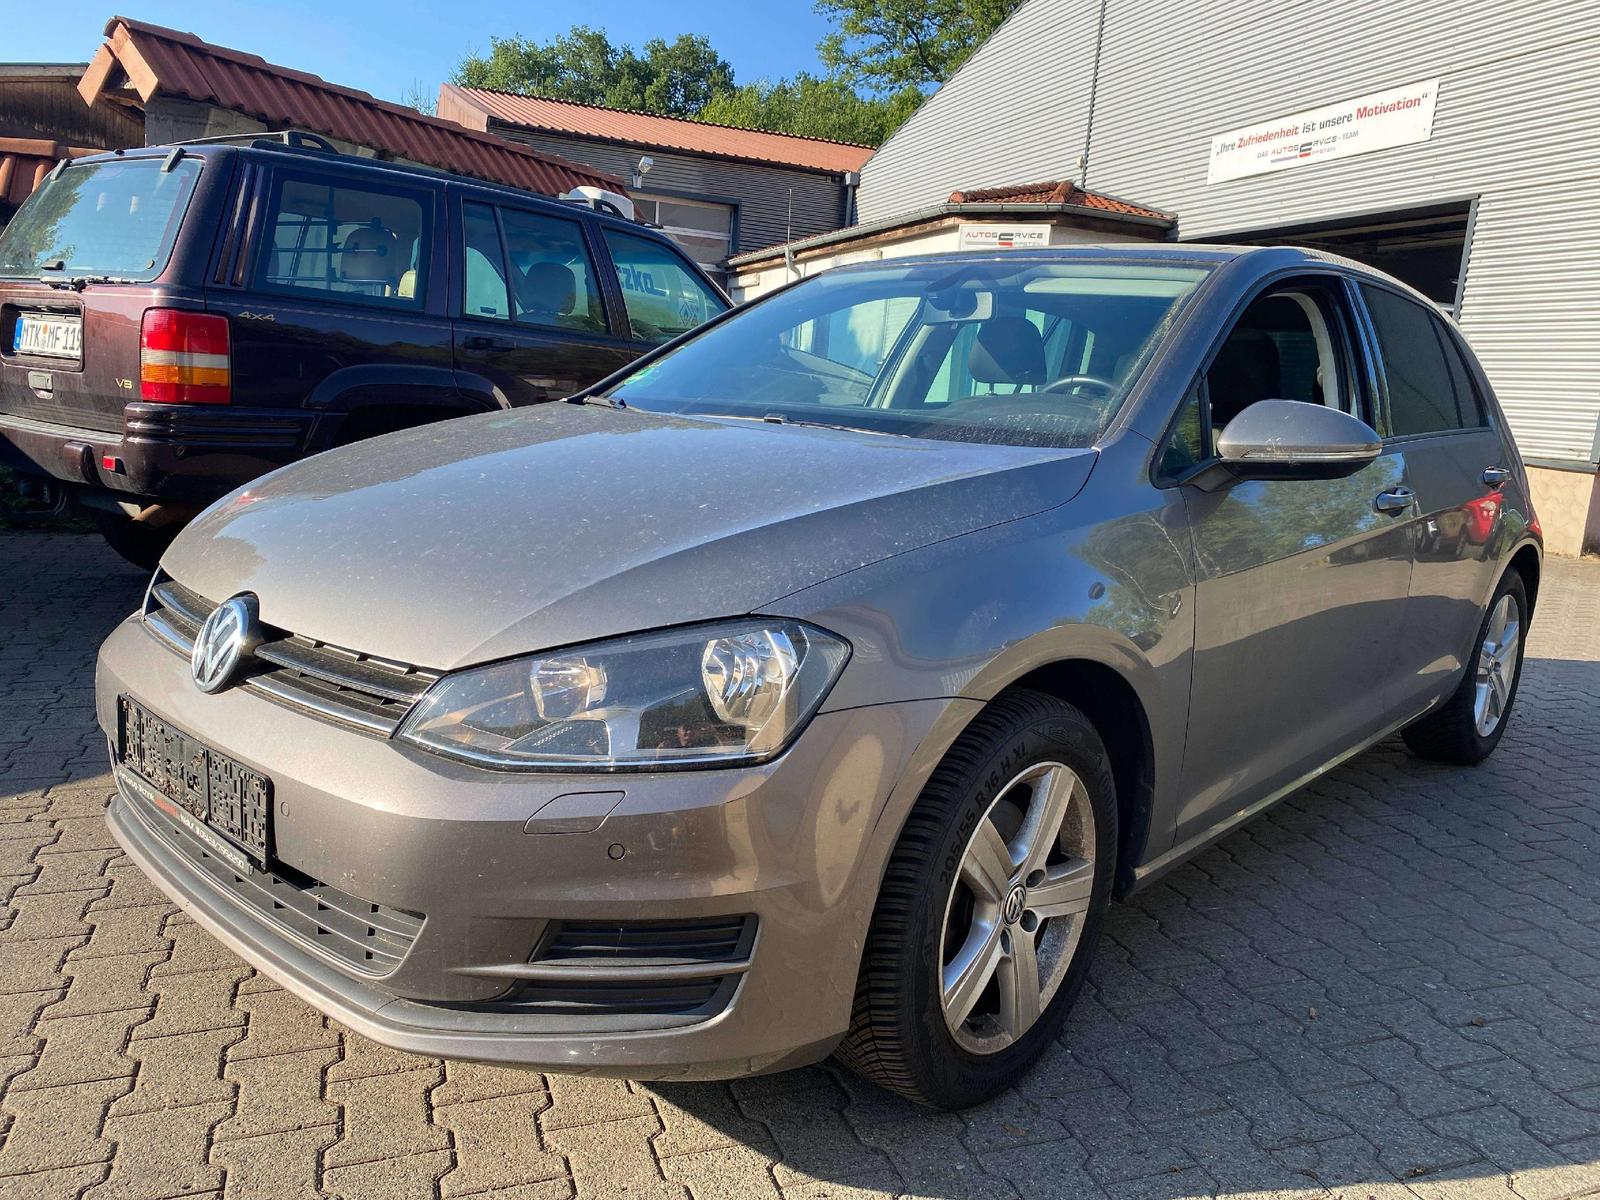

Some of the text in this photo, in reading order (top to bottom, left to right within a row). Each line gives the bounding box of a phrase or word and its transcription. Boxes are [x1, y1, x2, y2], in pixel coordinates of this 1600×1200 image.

[1237, 125, 1300, 149] Zufriedenheit
[1302, 121, 1317, 134] ist
[1319, 112, 1353, 130] unsere
[21, 323, 42, 347] MTK
[47, 324, 62, 349] MF
[115, 377, 133, 390] V8
[941, 741, 1028, 884] 205/55 R 16 H XL
